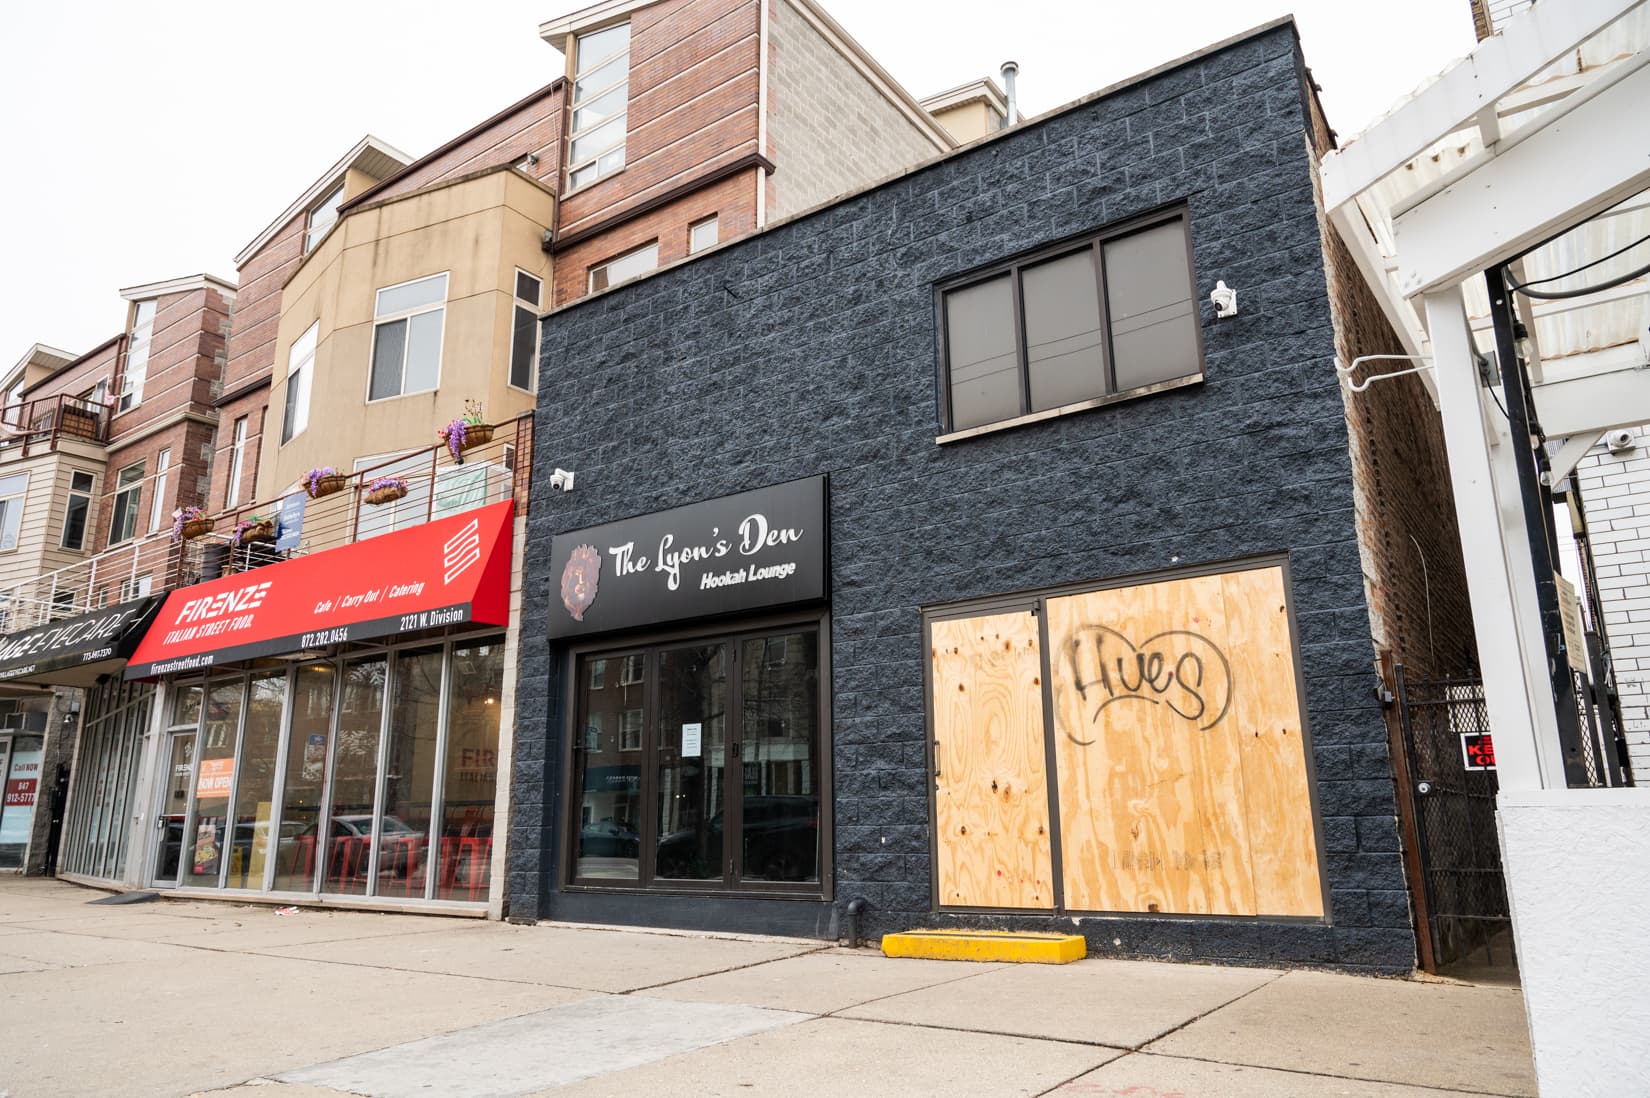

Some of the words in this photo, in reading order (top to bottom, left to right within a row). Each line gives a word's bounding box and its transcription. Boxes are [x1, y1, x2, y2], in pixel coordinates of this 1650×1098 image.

[609, 541, 650, 577] The
[655, 527, 732, 591] Lyon's
[738, 513, 804, 556] Den
[700, 568, 747, 590] Hookah
[748, 562, 797, 582] Lounge
[174, 581, 272, 625] FIRENZE
[314, 600, 332, 614] Cafe
[341, 594, 365, 608] Carry
[364, 589, 380, 603] Out
[389, 581, 425, 598] Catering
[28, 609, 136, 654] EYECARE
[163, 626, 198, 645] ITALIAN
[195, 619, 231, 639] STREET
[400, 613, 417, 631] 2121
[430, 608, 463, 626] Division
[151, 655, 214, 675] firenzestreetfood.com
